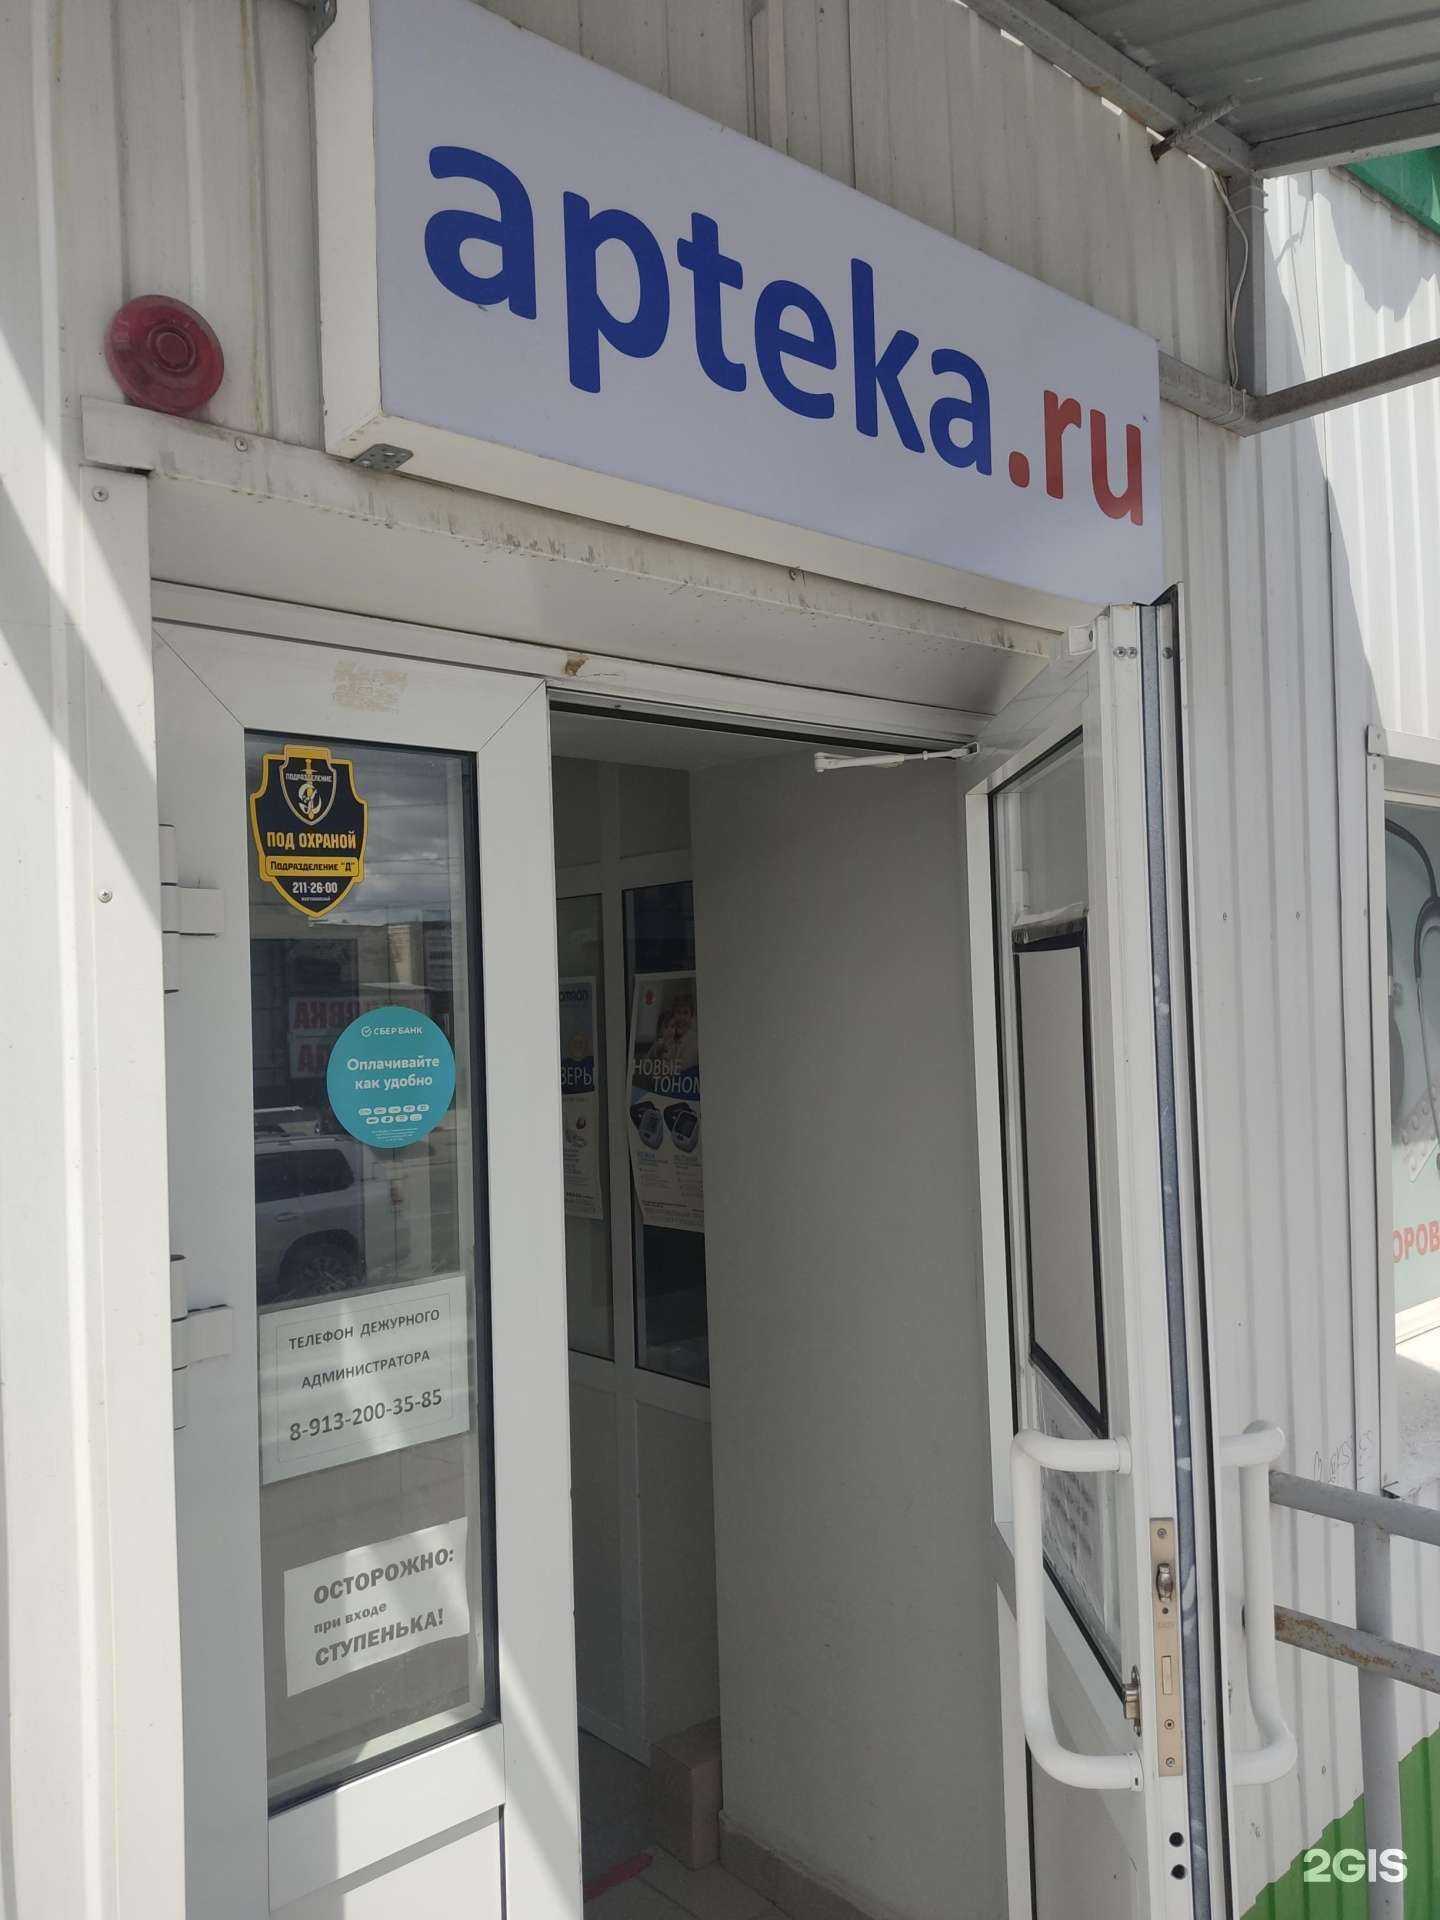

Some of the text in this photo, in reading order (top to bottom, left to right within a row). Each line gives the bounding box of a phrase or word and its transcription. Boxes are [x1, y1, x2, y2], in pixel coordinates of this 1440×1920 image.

[423, 145, 1143, 526] apteka.ru
[267, 830, 357, 850] ПОД ОХРАНОЙ
[292, 881, 338, 895] 211-26-00
[346, 1055, 440, 1072] Оплачивайте
[632, 1059, 682, 1077] НОВЫЕ
[355, 1074, 433, 1091] как удобно
[288, 1308, 440, 1350] ТЕЛЕФОН ДЕЖУРНОГО
[301, 1350, 430, 1389] АДМИНИСТРАТОРА
[289, 1388, 442, 1441] 8-913-200-35-85
[313, 1548, 454, 1604] ОСТОРОЖНО:
[314, 1602, 387, 1634] при входе
[315, 1608, 444, 1666] СТУПЕНЬКА!
